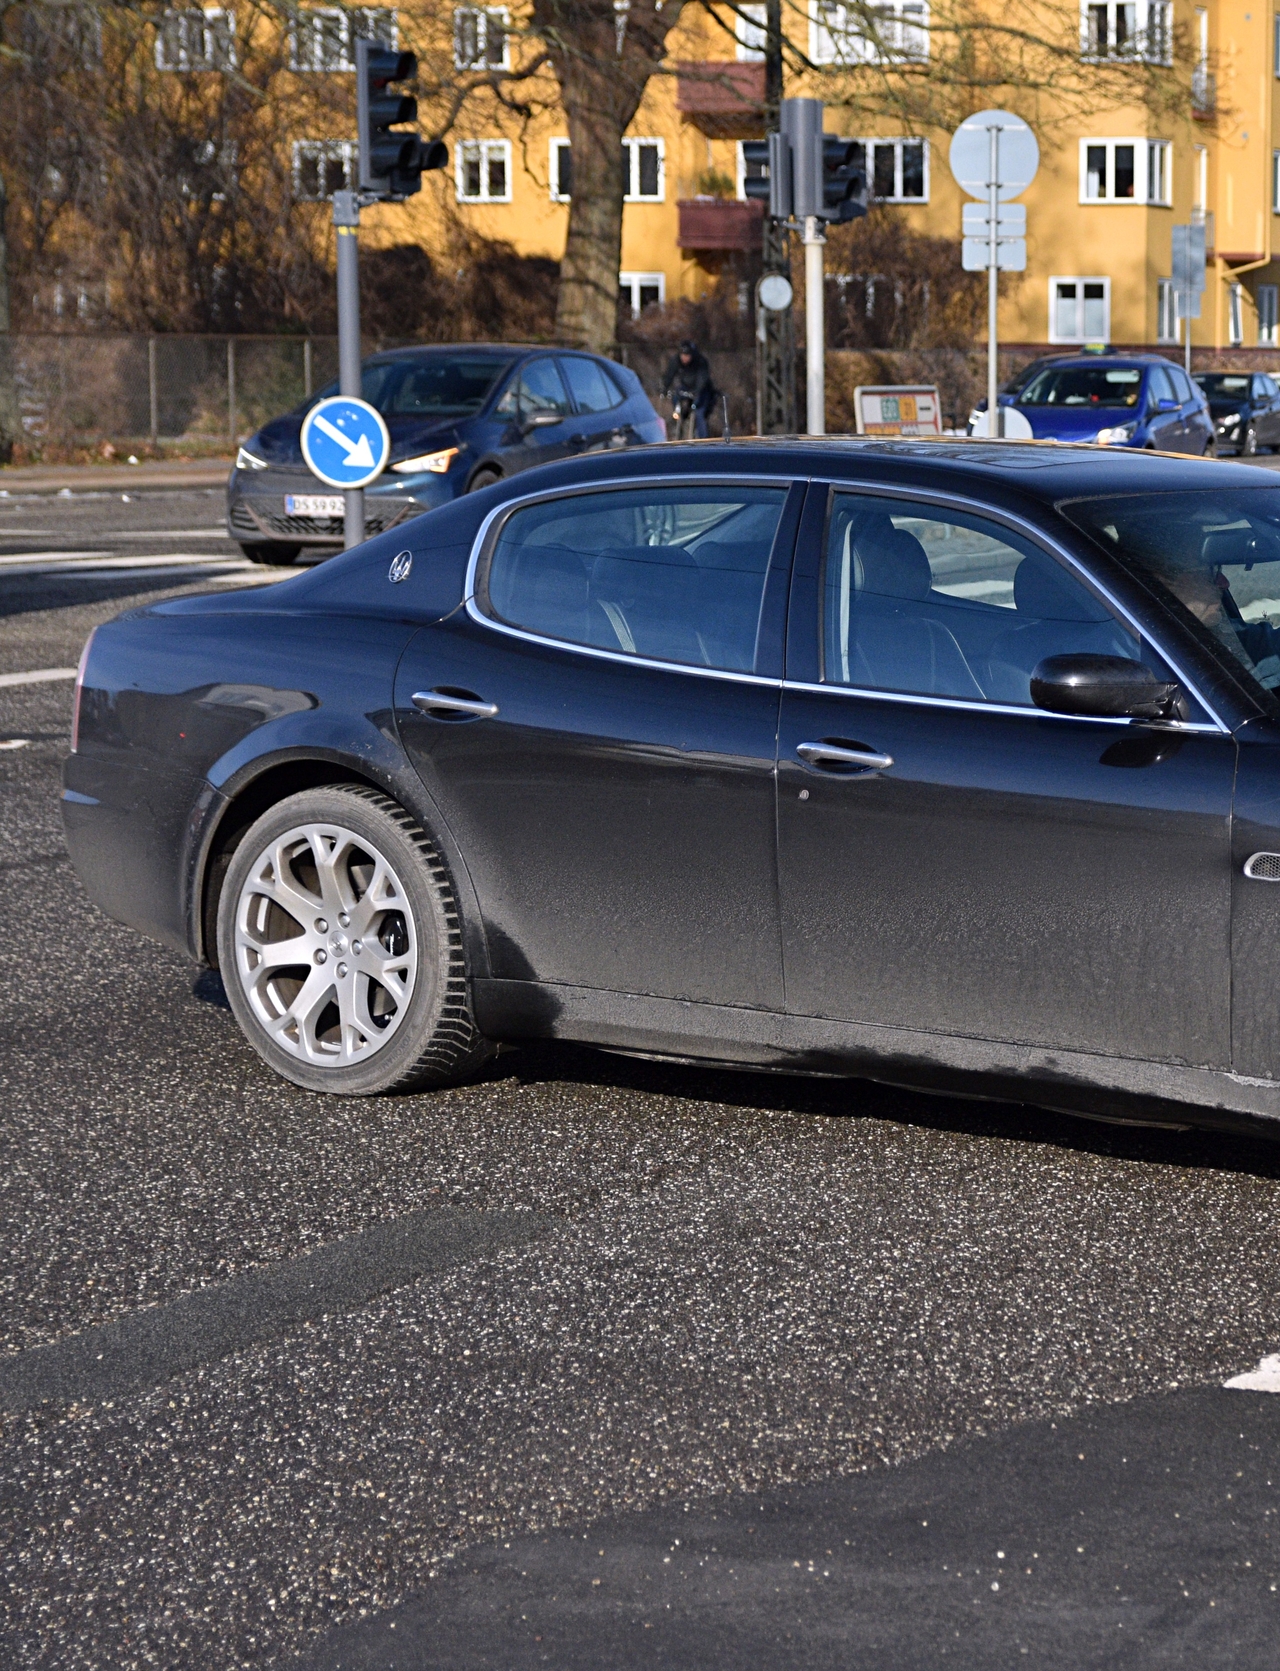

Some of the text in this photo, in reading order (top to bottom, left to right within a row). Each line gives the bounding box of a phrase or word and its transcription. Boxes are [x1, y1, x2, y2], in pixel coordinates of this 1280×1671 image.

[294, 499, 346, 511] DS 59 92
